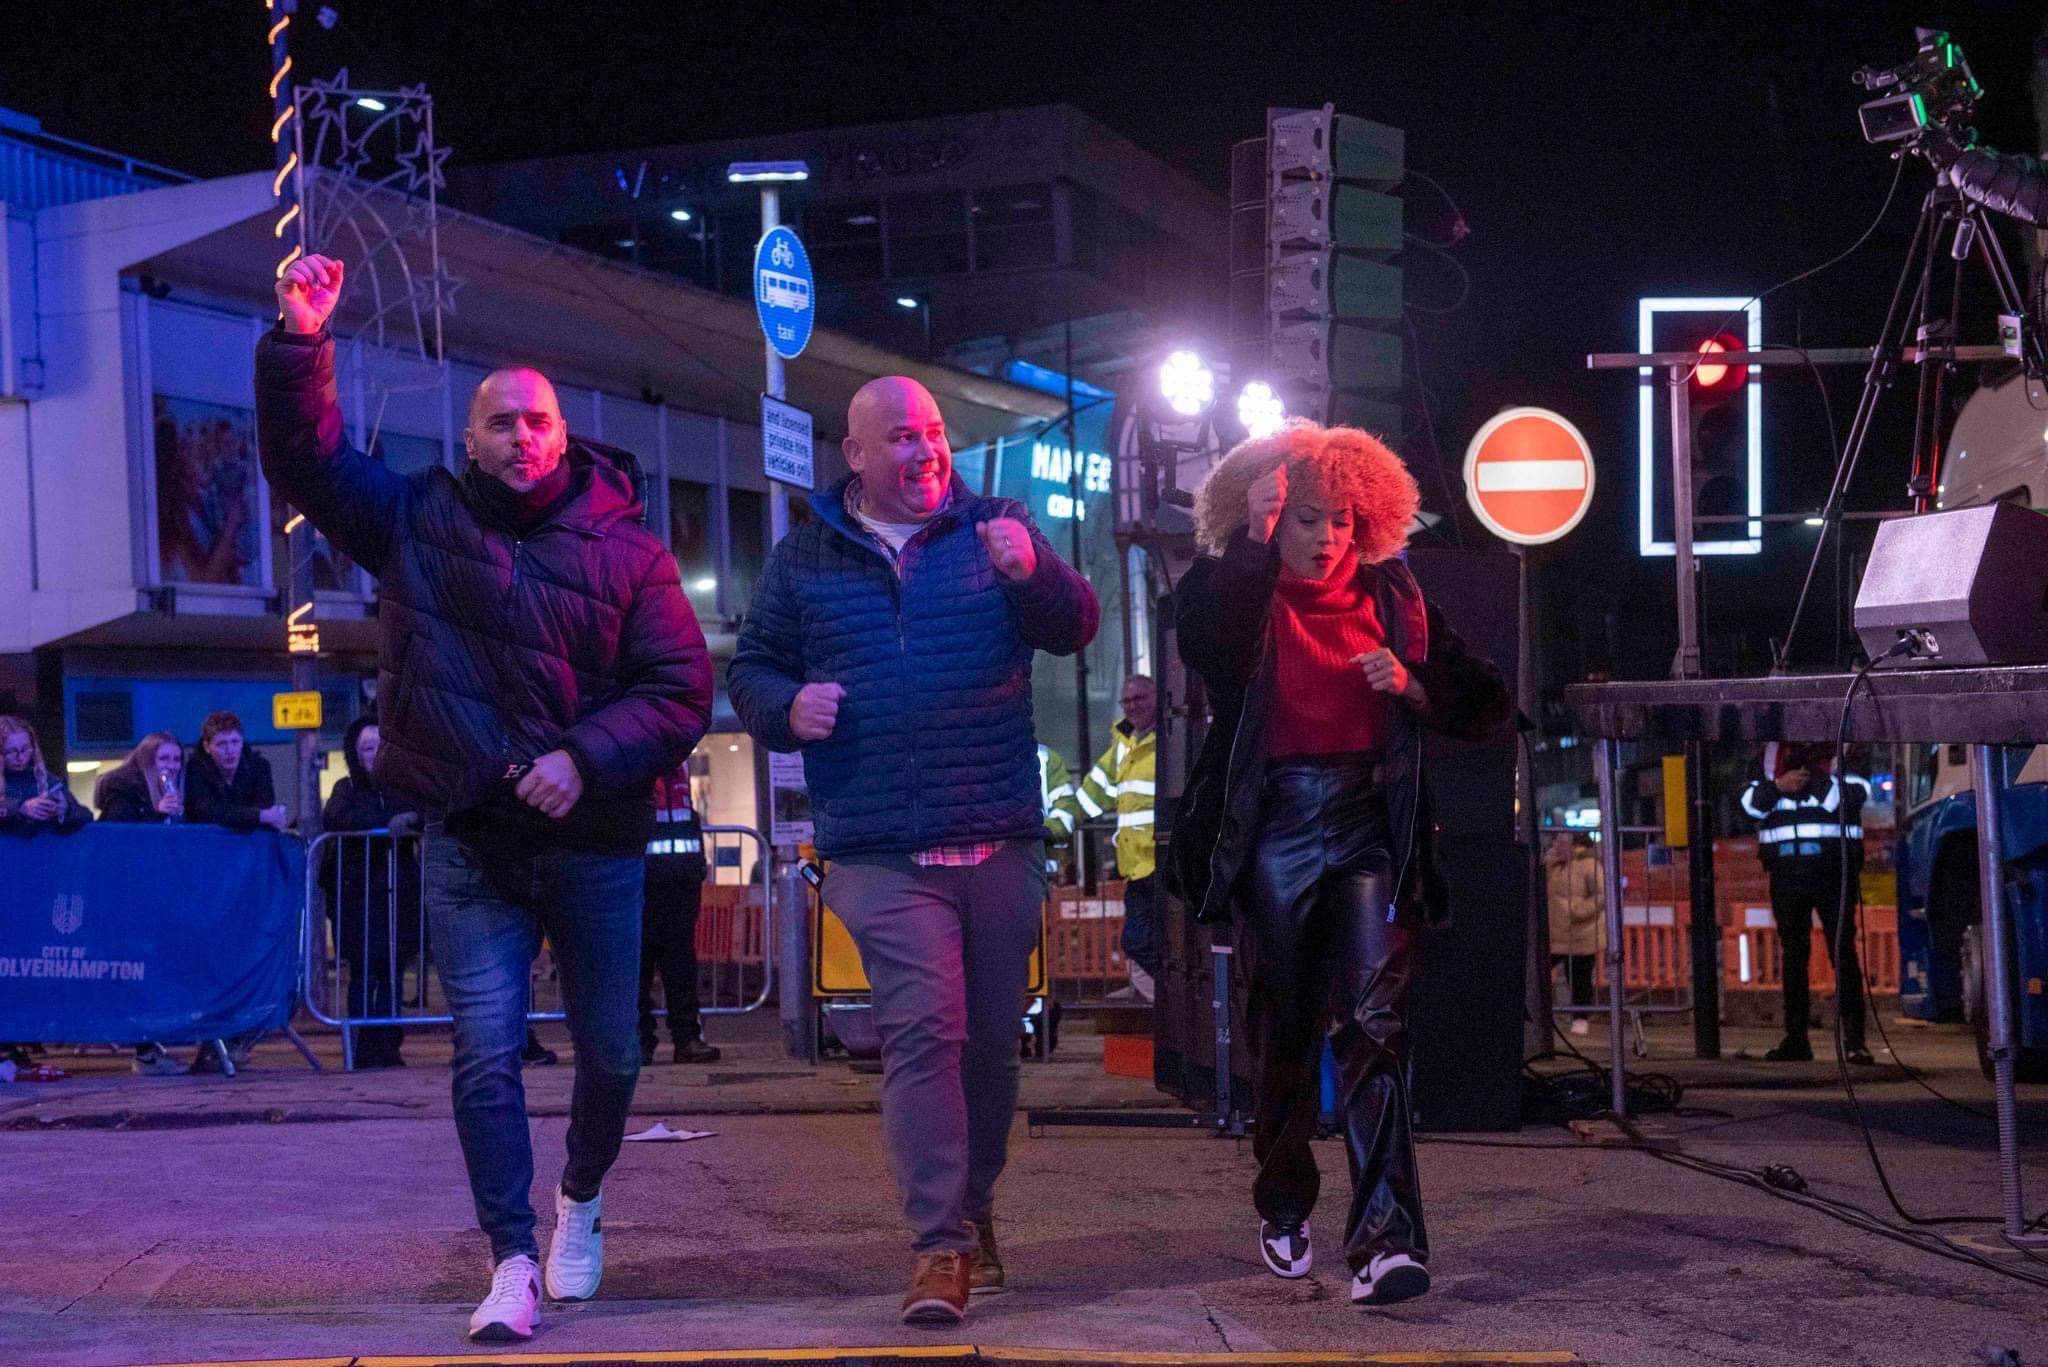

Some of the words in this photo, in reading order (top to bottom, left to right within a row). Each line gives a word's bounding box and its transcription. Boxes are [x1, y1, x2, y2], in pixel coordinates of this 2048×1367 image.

[777, 322, 796, 341] taxi
[766, 409, 780, 426] and
[781, 413, 810, 436] licensed
[768, 433, 794, 454] private
[795, 440, 809, 458] hire
[767, 453, 796, 476] vehicles
[796, 463, 811, 483] only
[41, 945, 69, 958] CITY
[71, 946, 87, 959] OF
[0, 956, 145, 981] OLVERHAMPTON
